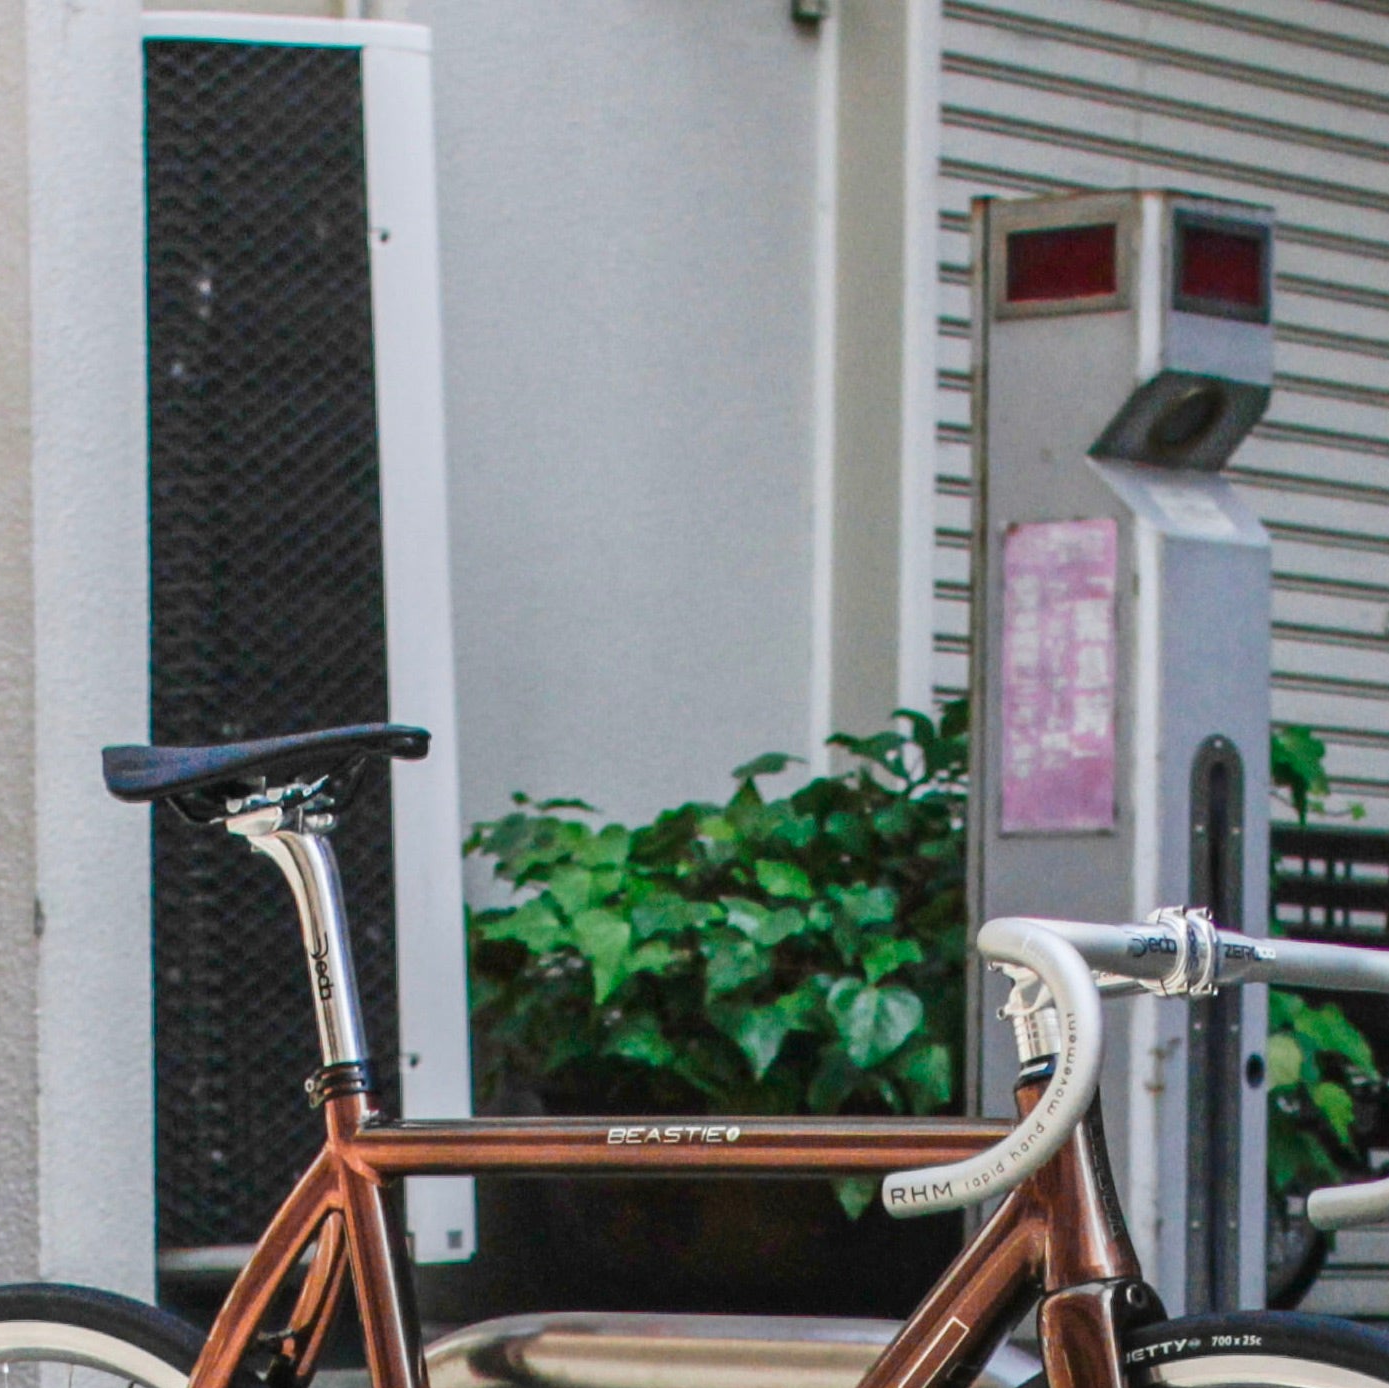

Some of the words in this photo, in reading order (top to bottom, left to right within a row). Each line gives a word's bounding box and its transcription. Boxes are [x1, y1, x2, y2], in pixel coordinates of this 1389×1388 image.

[890, 1182, 954, 1205] RHM
[964, 1160, 1006, 1190] rapid
[1009, 1121, 1046, 1162] hand
[1047, 1012, 1078, 1117] movement
[607, 1125, 727, 1145] BEASTIE
[1212, 1335, 1232, 1347] 700
[1242, 1335, 1263, 1347] 25c
